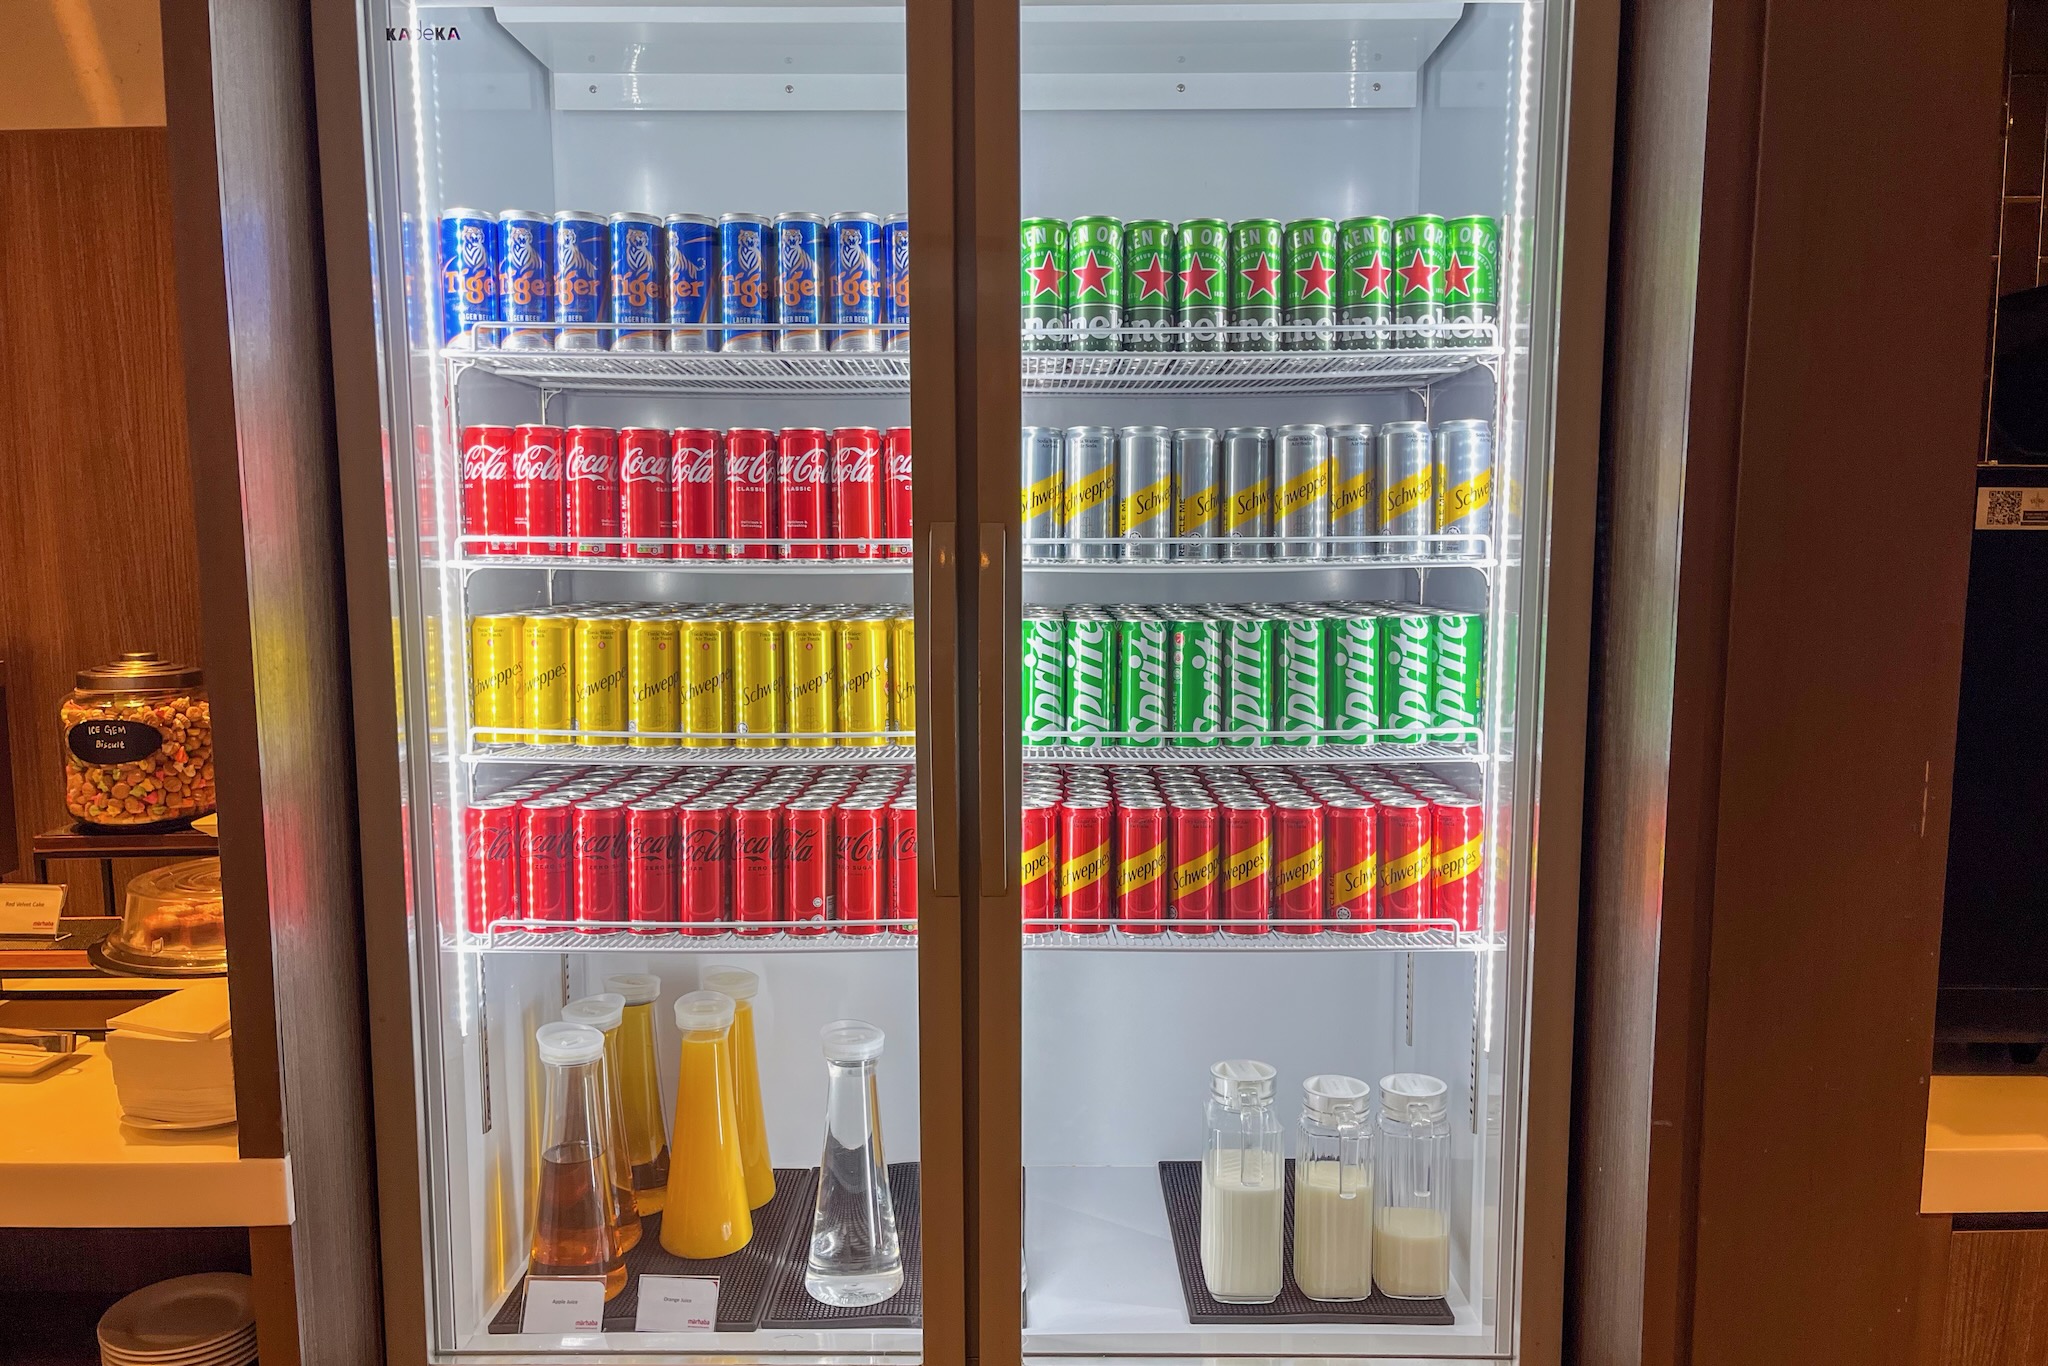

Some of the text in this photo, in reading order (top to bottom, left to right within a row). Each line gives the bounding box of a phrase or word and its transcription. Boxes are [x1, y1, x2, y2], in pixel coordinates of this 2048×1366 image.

[1343, 226, 1375, 252] KEN
[88, 725, 126, 735] ICE GEM
[1024, 620, 1065, 746] Sprite
[1067, 620, 1109, 747] Sprite
[1129, 620, 1168, 747] Sprite
[1224, 620, 1269, 748] Sprite
[1279, 618, 1325, 746] Sprite
[1335, 618, 1379, 746] Sprite
[1387, 616, 1431, 744] Sprite
[1431, 615, 1475, 742] Sprite
[95, 740, 125, 749] Biscuit
